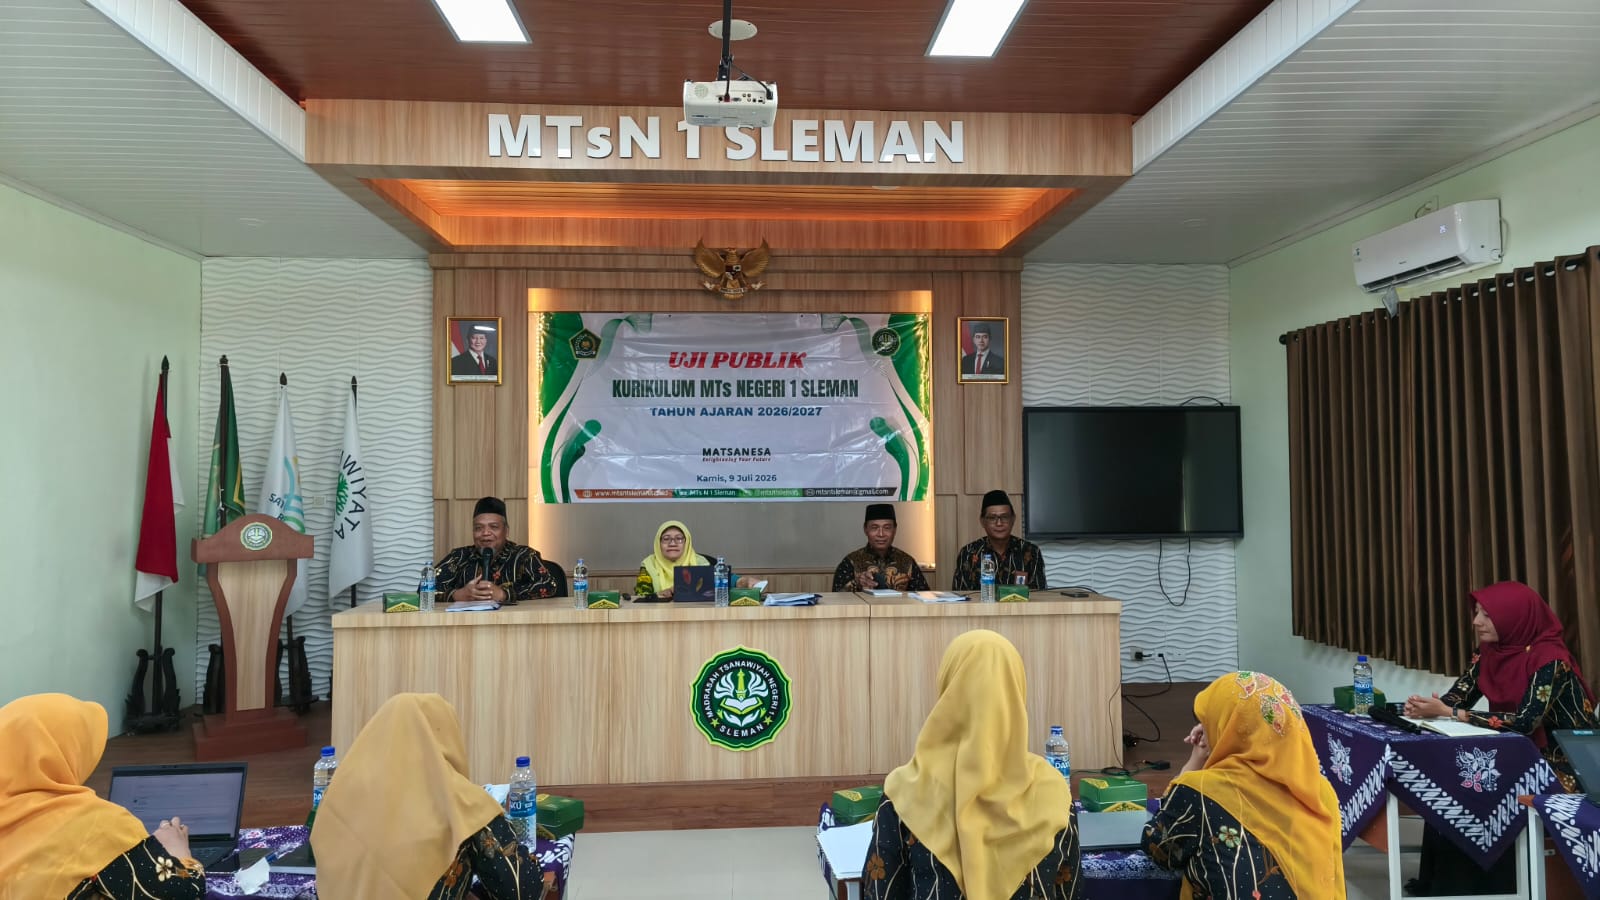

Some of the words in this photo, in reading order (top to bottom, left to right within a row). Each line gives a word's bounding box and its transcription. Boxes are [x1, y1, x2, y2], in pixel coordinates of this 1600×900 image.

[488, 113, 660, 159] MTsN
[678, 120, 701, 159] 1
[725, 119, 964, 163] SLEMAN
[669, 352, 708, 368] UJI
[711, 352, 807, 368] PUBLIK
[612, 379, 695, 398] KURIKULUM
[700, 379, 731, 398] MTs
[736, 379, 786, 398] NEGERI
[789, 379, 796, 398] 1
[801, 379, 858, 398] SLEMAN
[650, 407, 695, 417] TAHUN
[700, 407, 753, 417] AJARAN
[758, 407, 822, 417] 2026/2027
[702, 447, 771, 456] MATSANESA
[696, 474, 727, 483] Kamis,
[728, 474, 735, 482] 9
[737, 474, 753, 482] Juli
[755, 474, 777, 482] 2026
[704, 672, 719, 718] MADRASAH
[719, 661, 770, 678] TSANAWIYAH
[768, 678, 778, 709] NEGERI
[719, 723, 764, 737] SLEMAN
